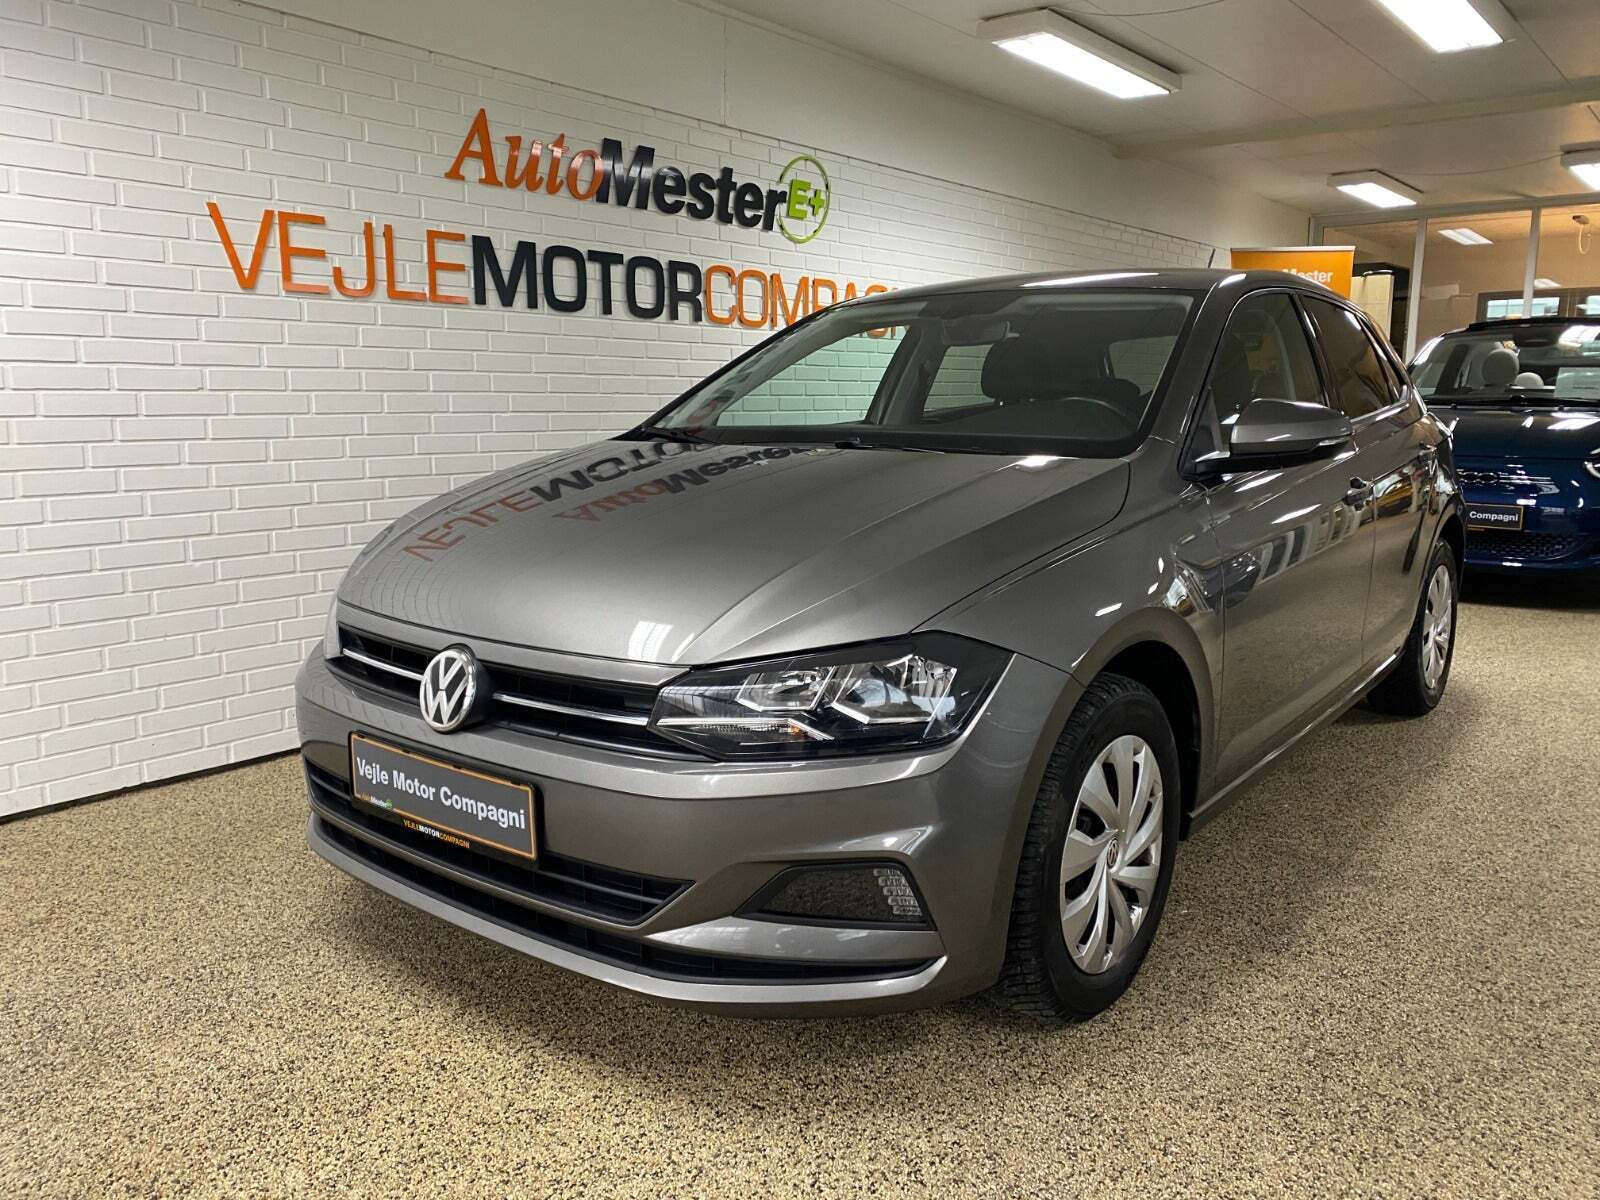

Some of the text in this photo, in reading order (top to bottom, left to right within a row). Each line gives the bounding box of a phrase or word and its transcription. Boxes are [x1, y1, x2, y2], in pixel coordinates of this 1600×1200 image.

[445, 108, 787, 231] AutoMester
[1469, 511, 1519, 522] Compagni
[357, 757, 389, 785] Vejle
[392, 770, 436, 801] Motor
[440, 786, 526, 829] Compagni
